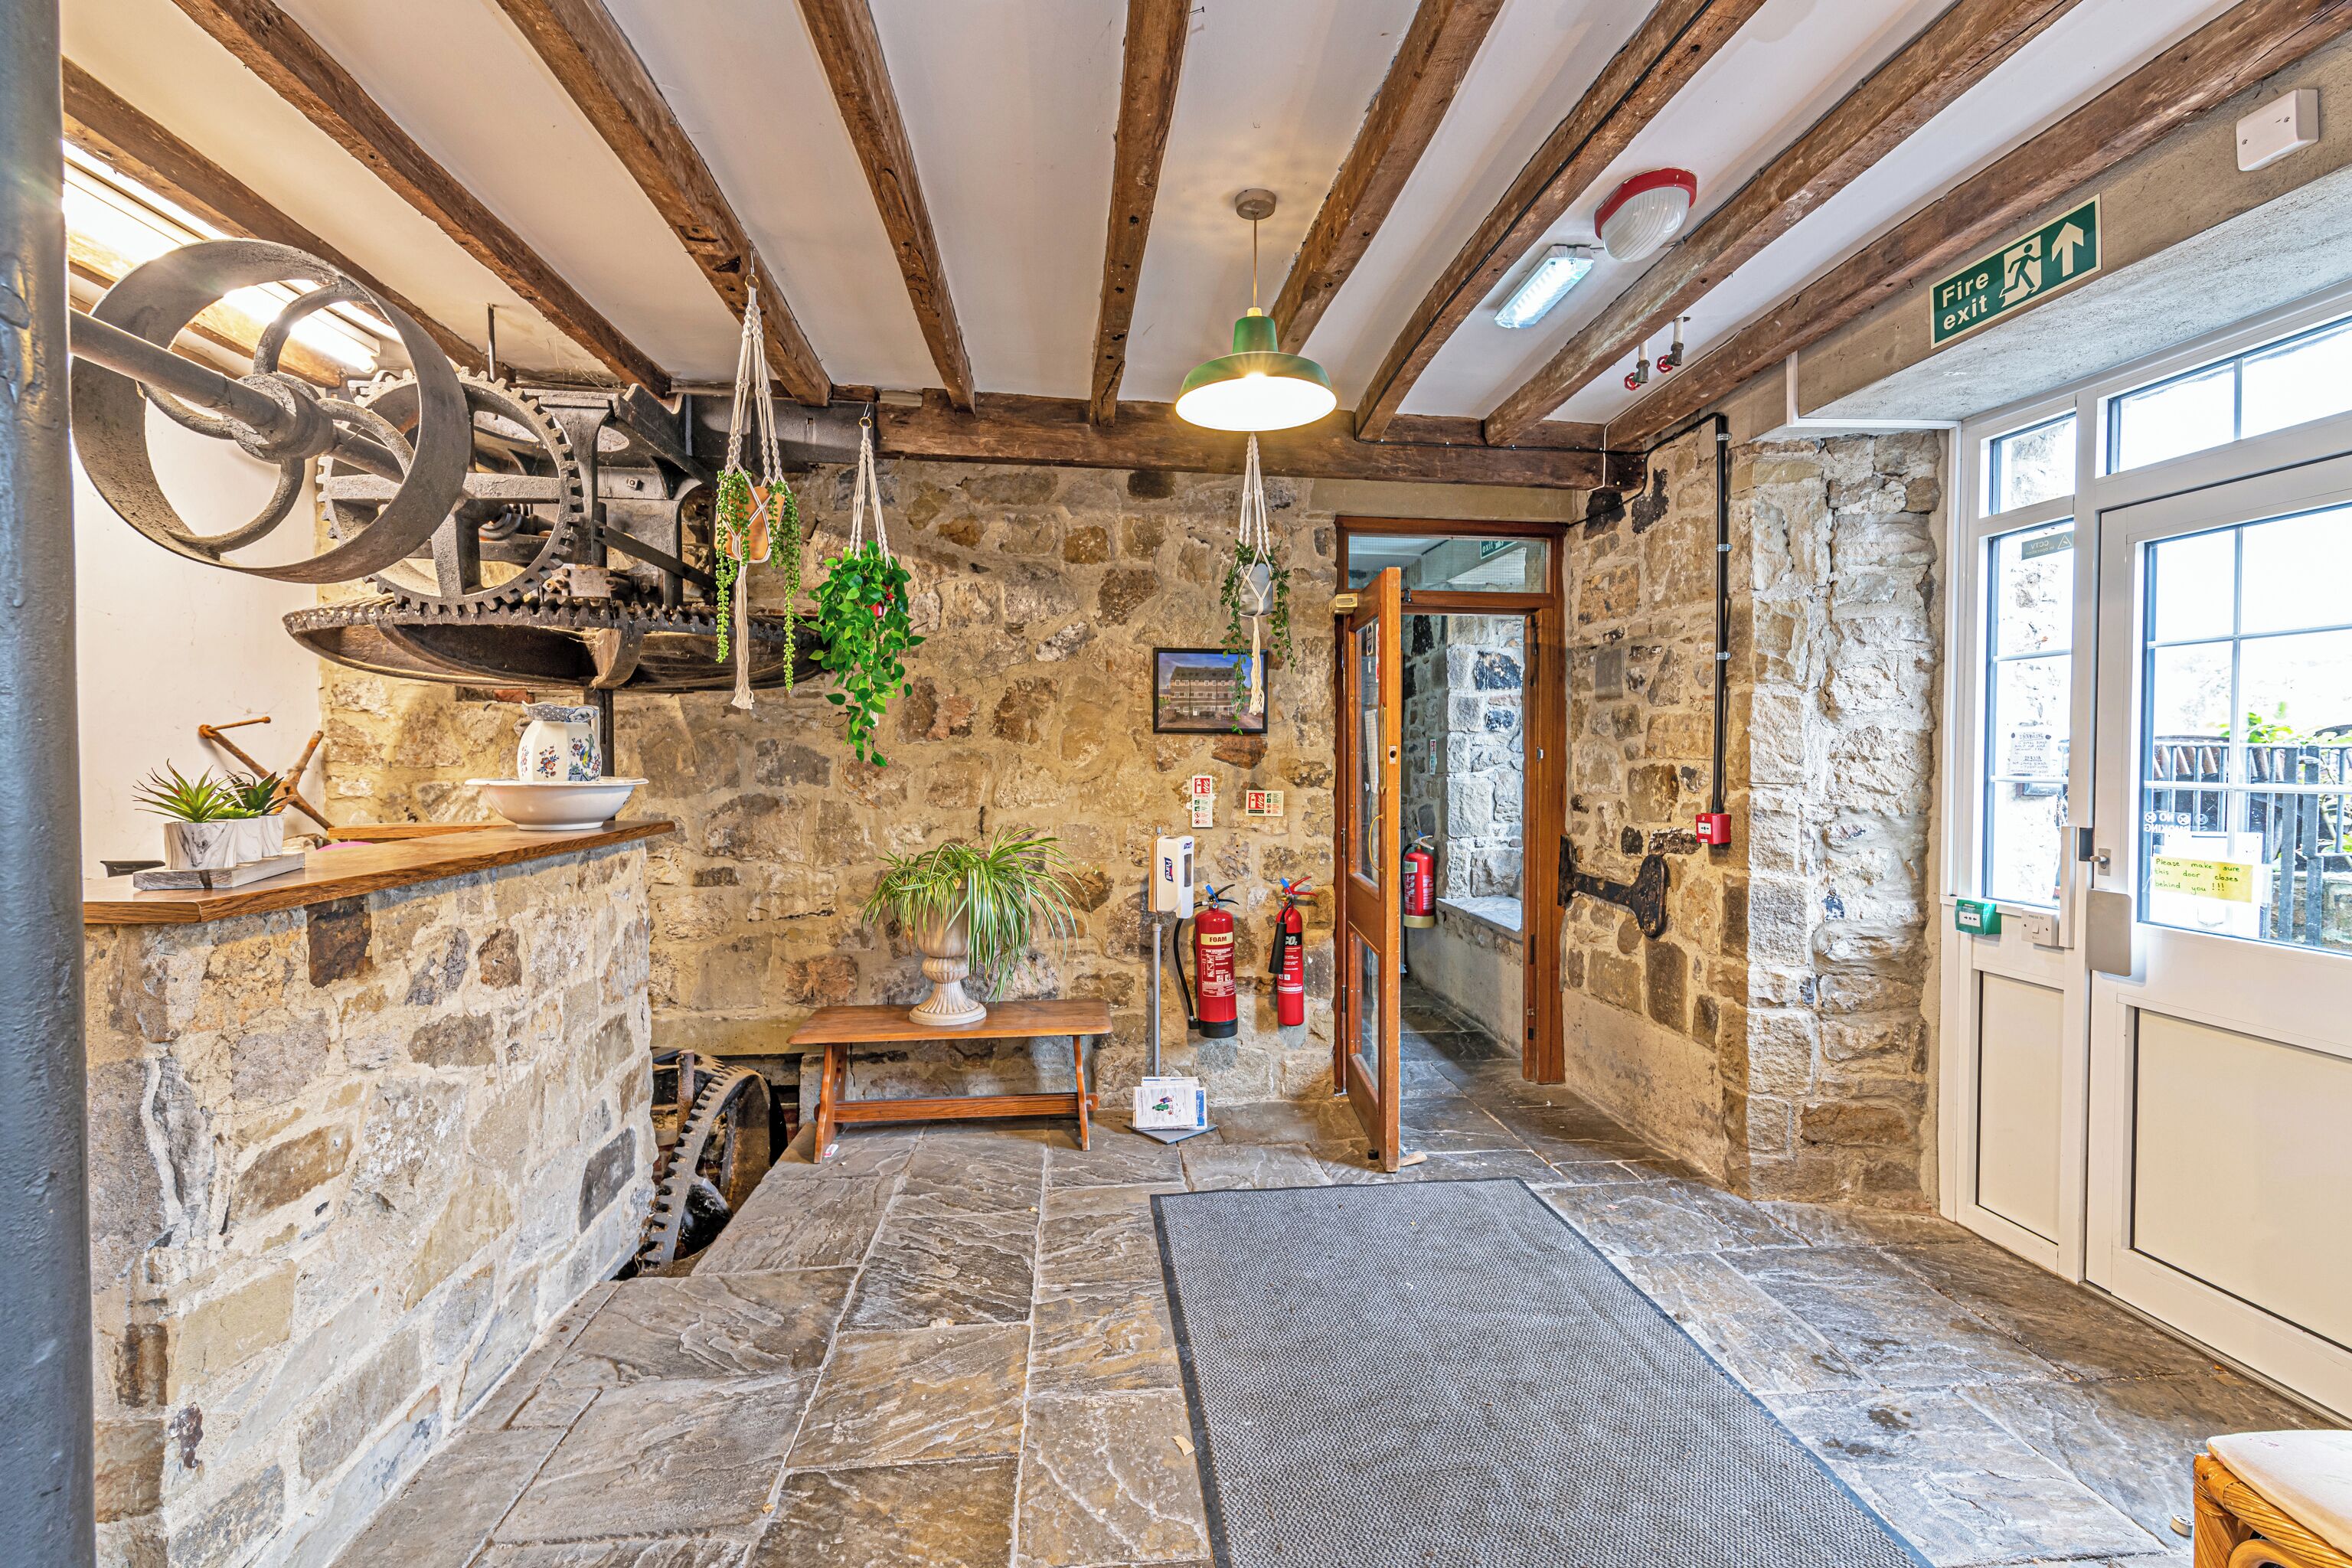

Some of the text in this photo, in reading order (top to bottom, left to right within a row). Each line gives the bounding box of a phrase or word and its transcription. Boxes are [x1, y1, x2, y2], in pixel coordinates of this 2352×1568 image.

[1942, 273, 1989, 308] Fire
[1943, 295, 1988, 330] exit
[2155, 858, 2180, 867] Please
[2190, 861, 2213, 870] make
[2214, 874, 2239, 882] closes
[2155, 880, 2180, 889] behind
[2191, 886, 2206, 895] you
